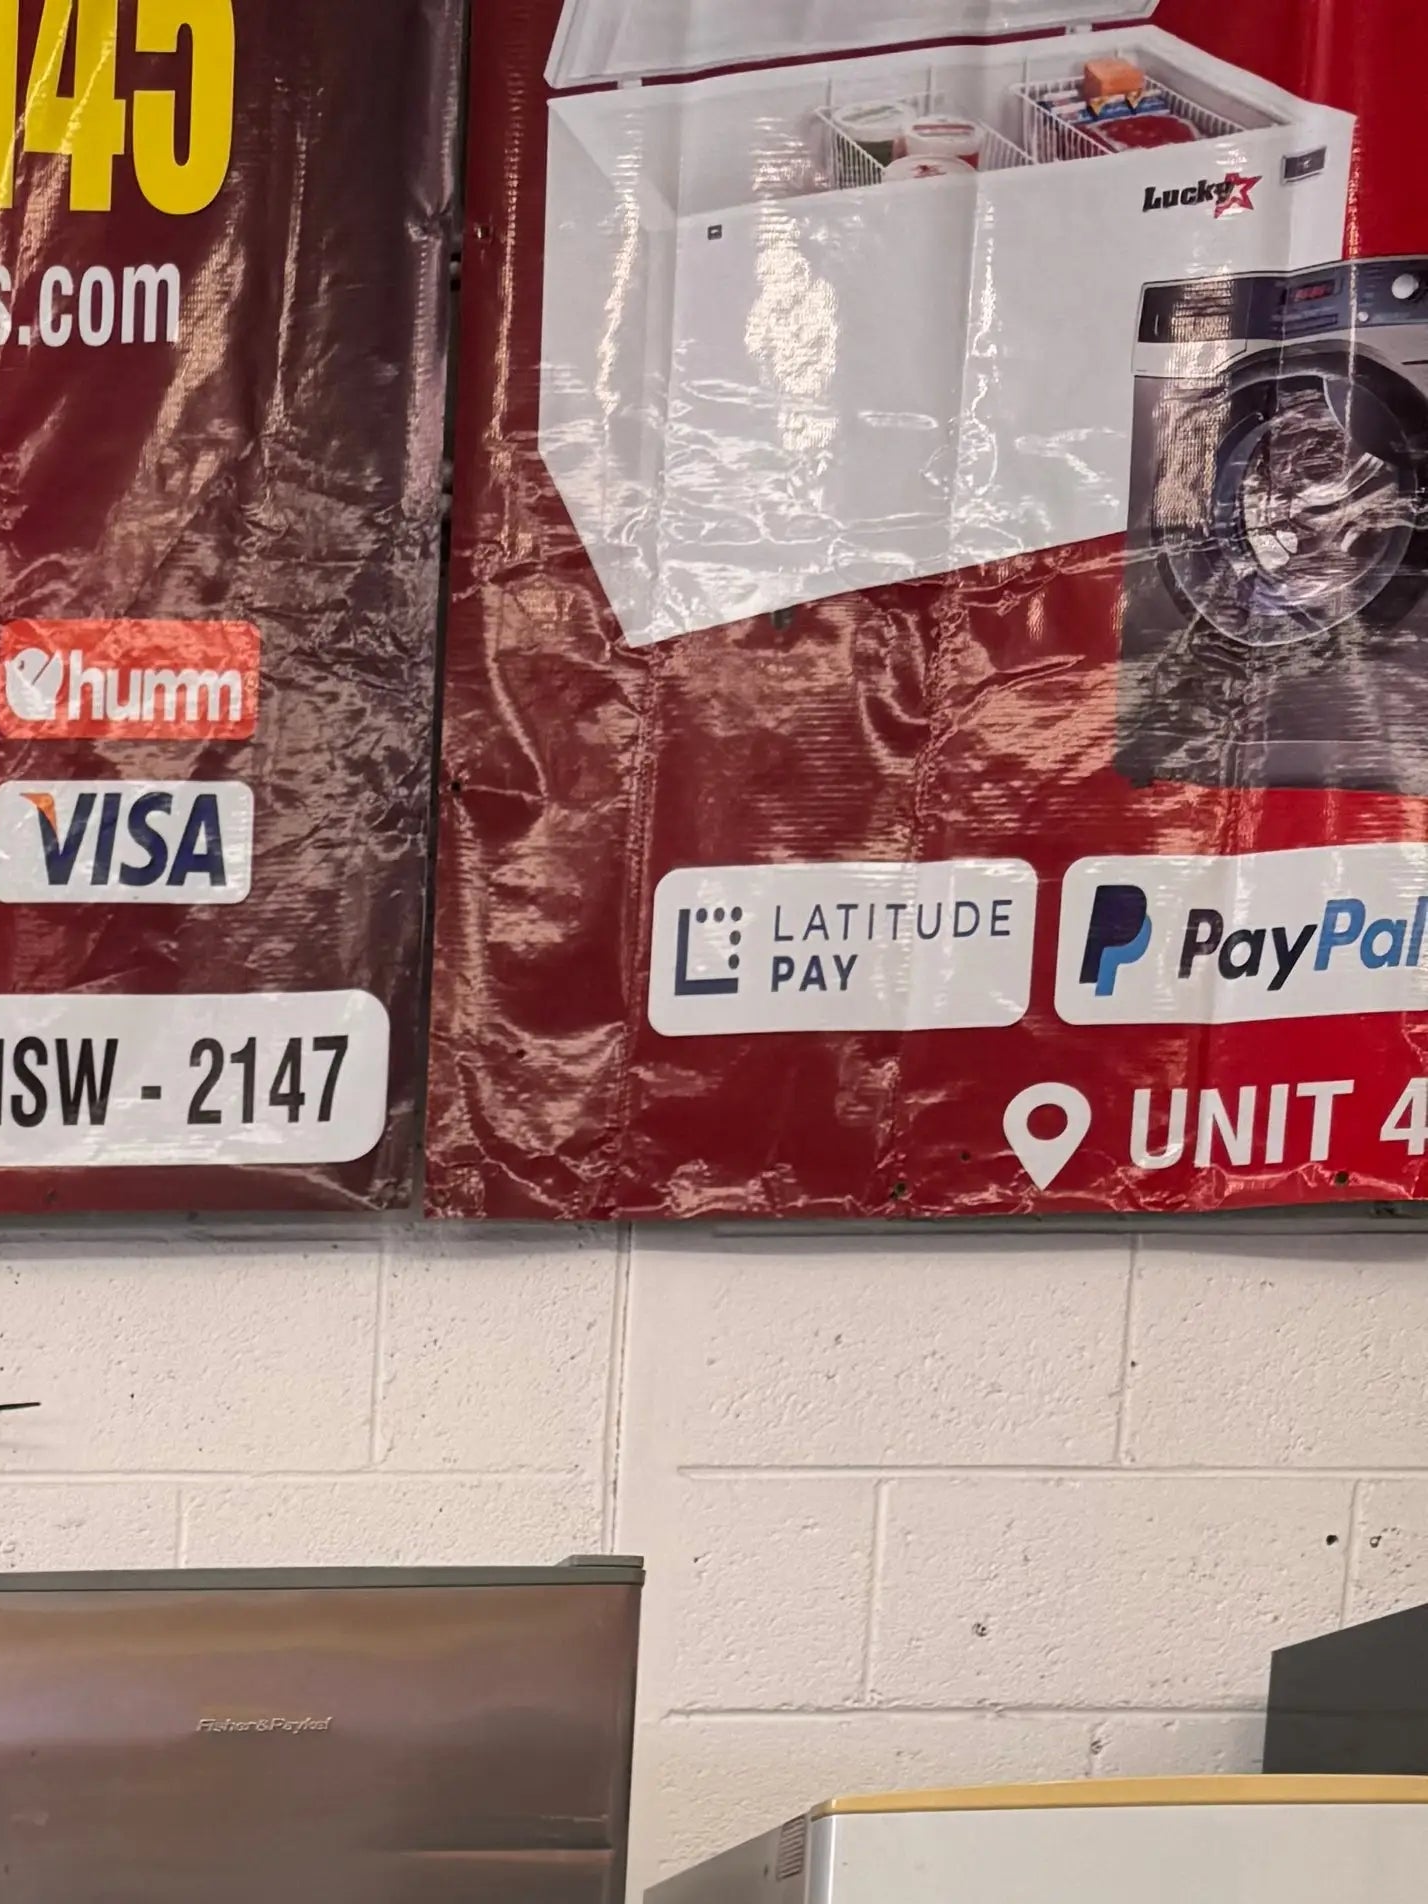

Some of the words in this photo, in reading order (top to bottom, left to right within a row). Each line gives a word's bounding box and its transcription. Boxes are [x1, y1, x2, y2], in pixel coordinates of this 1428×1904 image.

[1142, 179, 1234, 213] Lucky
[65, 653, 246, 723] humm
[23, 791, 226, 887] VISA
[774, 898, 1013, 943] LATITUDE
[1178, 894, 1428, 993] PayPal
[771, 954, 858, 993] PAY
[187, 1032, 350, 1126] 2147
[1130, 1079, 1354, 1171] UNIT
